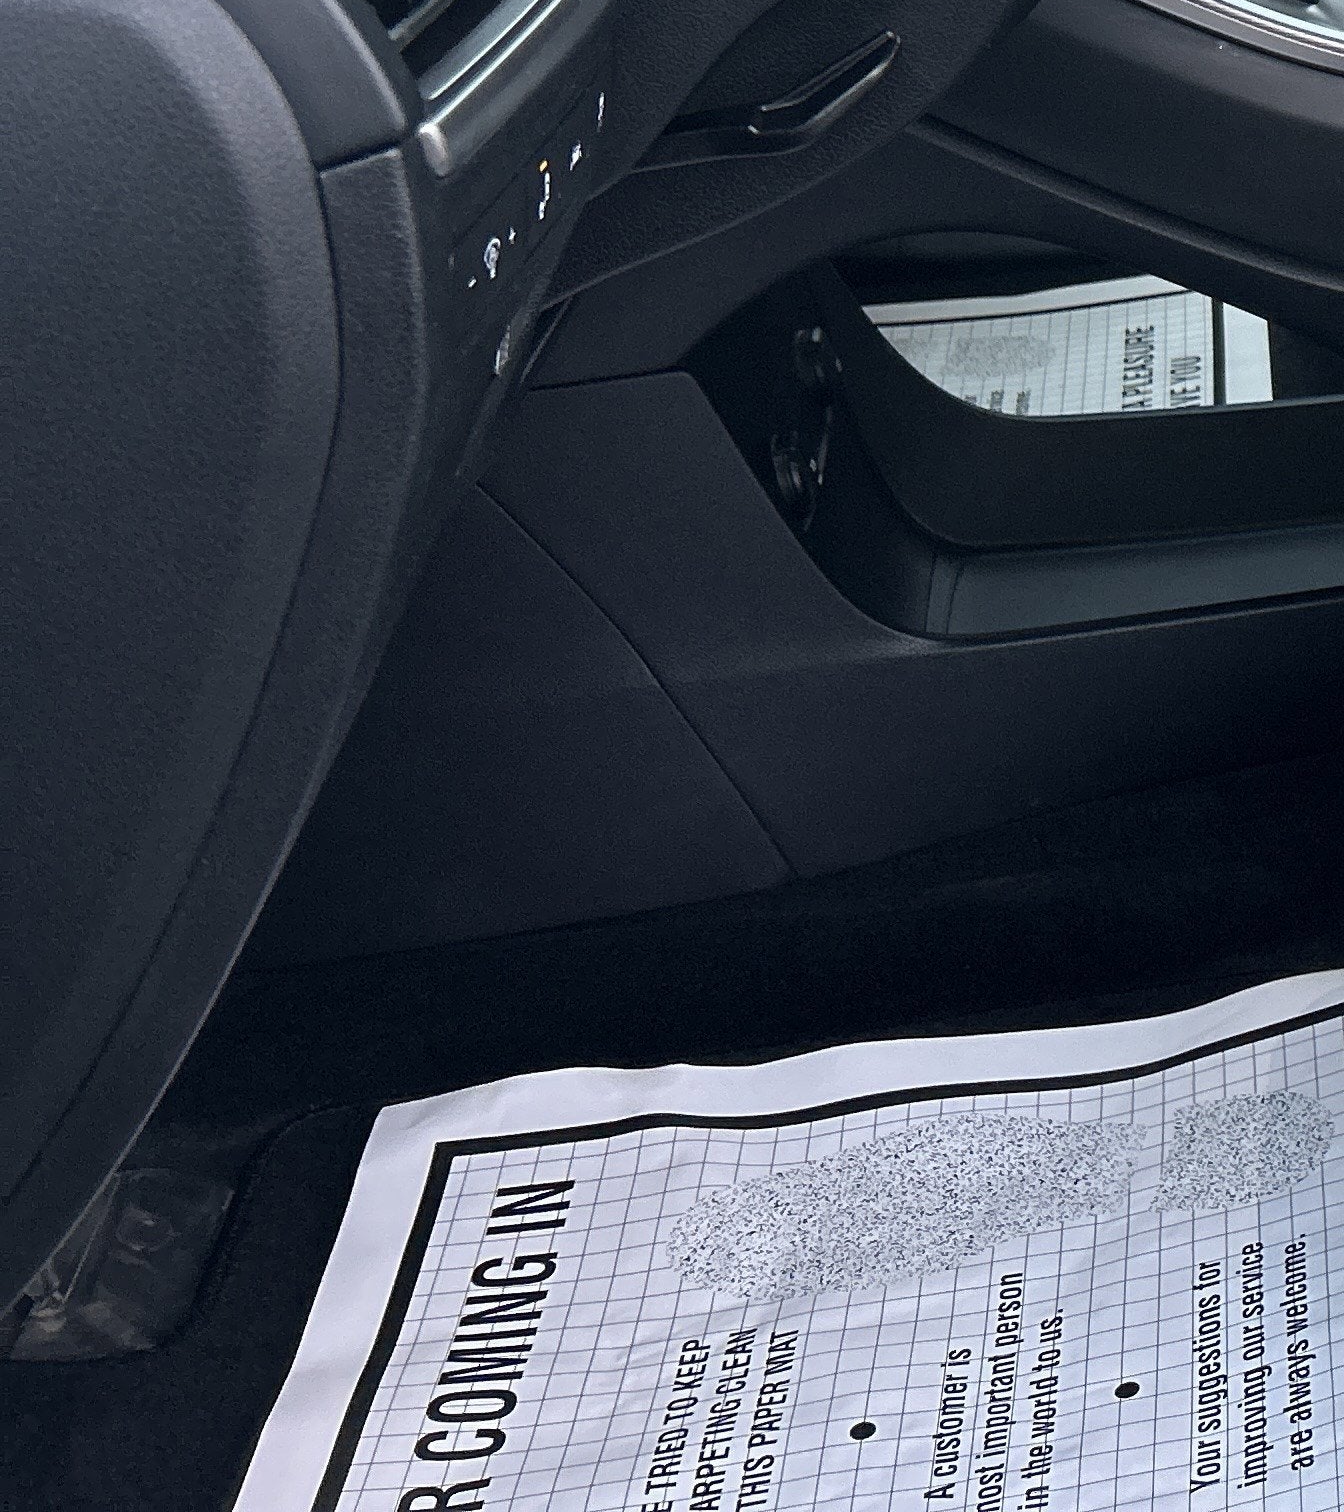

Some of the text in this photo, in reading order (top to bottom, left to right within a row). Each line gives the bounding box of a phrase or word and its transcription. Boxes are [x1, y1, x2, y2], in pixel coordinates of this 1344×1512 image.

[1122, 325, 1154, 398] PLEASURE
[1170, 356, 1201, 385] YOU
[486, 1180, 576, 1236] IN
[414, 1252, 559, 1461] COMING
[673, 1339, 711, 1392] KEEP
[995, 1272, 1025, 1347] person
[1235, 1241, 1274, 1489] improving our service
[1280, 1233, 1317, 1471] are always welcome.
[663, 1396, 698, 1425] TO
[689, 1328, 758, 1511] ARPETING CLEAN
[736, 1329, 799, 1512] THIS PAPER MAT
[924, 1348, 972, 1499] A customer is
[975, 1352, 1017, 1459] important
[1017, 1309, 1064, 1510] in the world to us.
[1189, 1262, 1228, 1494] Your suggestions for
[645, 1429, 688, 1495] TRIED
